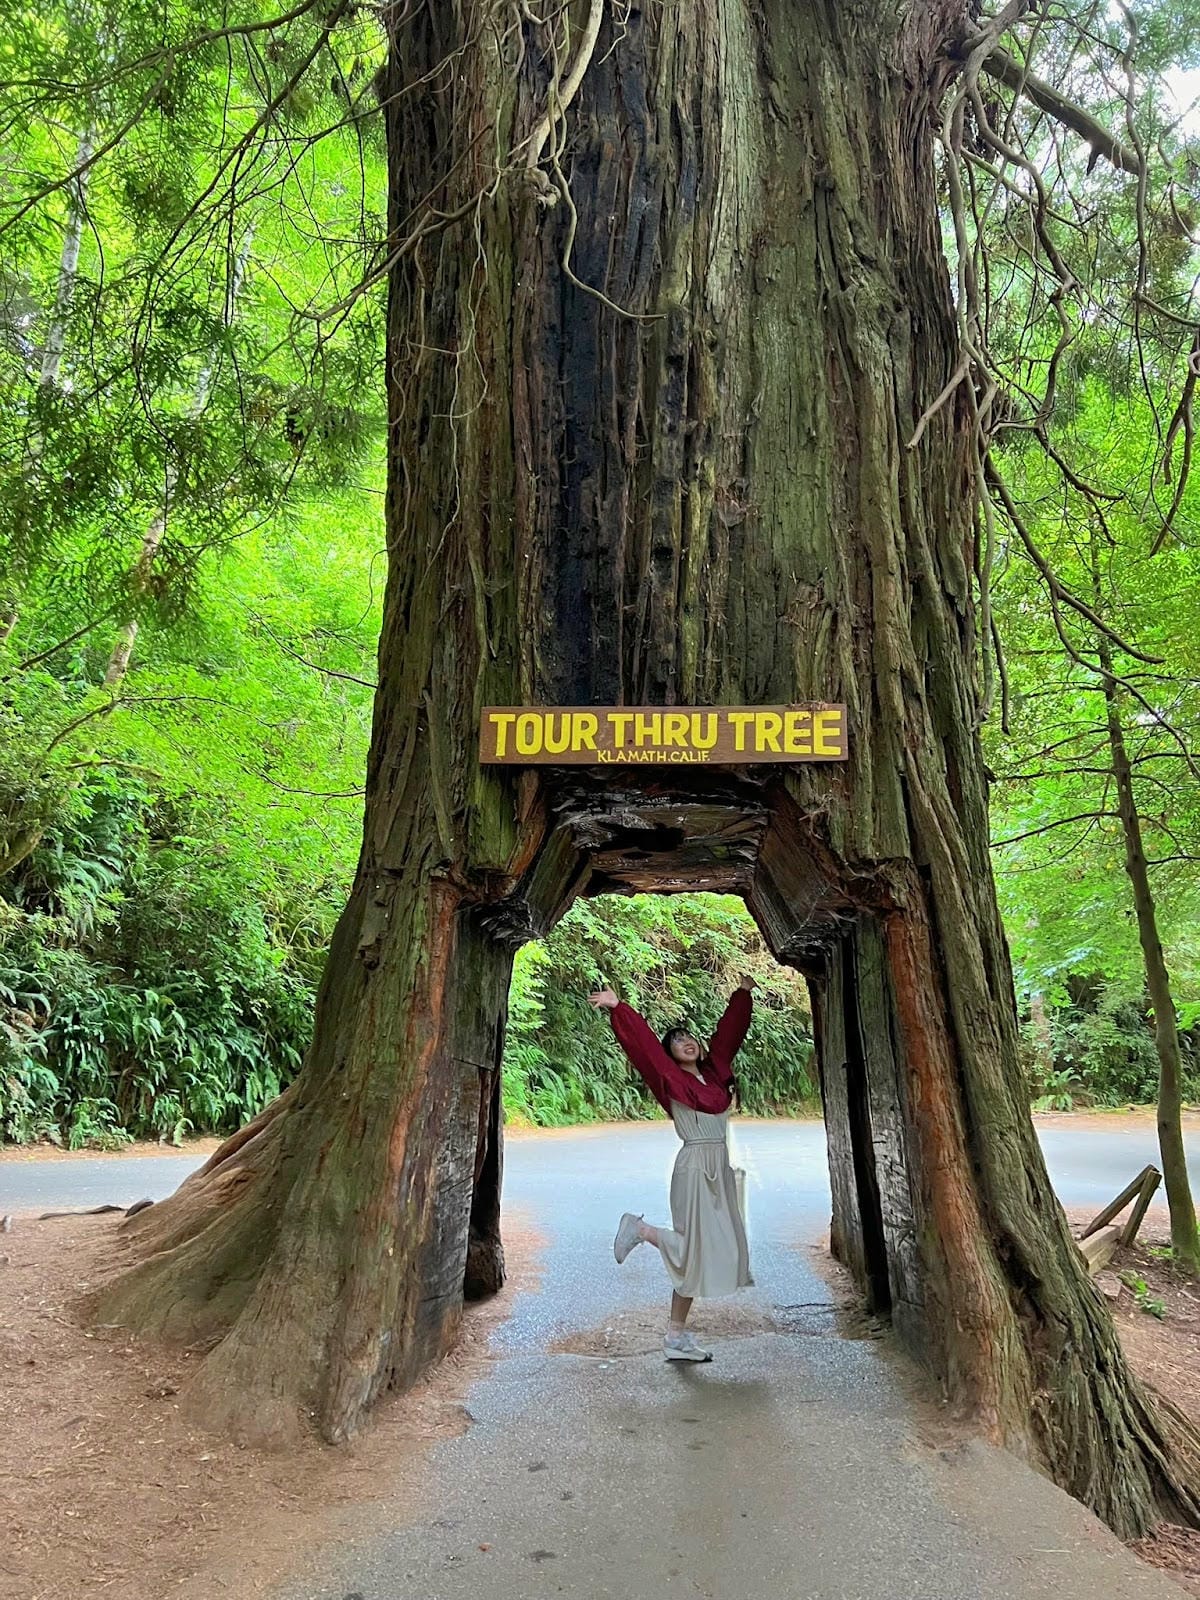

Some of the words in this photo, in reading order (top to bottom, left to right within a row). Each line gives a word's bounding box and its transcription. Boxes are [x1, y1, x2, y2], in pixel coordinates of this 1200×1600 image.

[489, 713, 598, 757] TOUR
[607, 713, 718, 749] THRU
[728, 710, 841, 755] TREE
